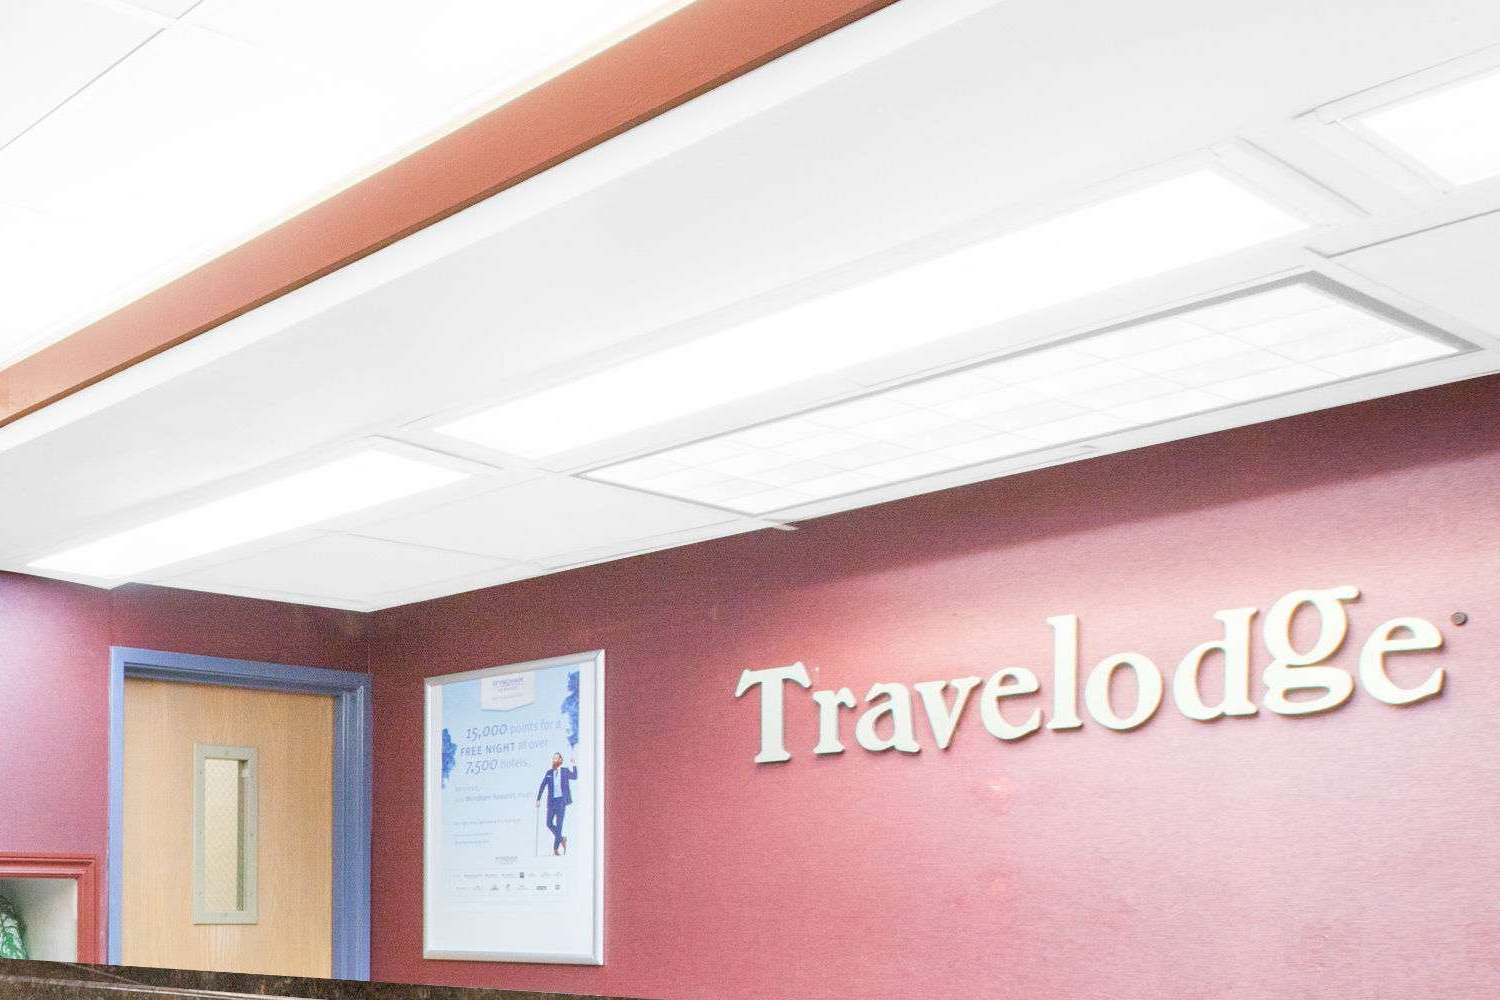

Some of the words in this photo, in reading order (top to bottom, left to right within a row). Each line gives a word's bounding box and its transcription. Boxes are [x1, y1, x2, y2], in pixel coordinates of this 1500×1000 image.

[734, 585, 1446, 763] Travelodge
[466, 724, 508, 741] 15,000
[510, 721, 538, 736] points
[460, 745, 482, 757] FREE
[485, 742, 515, 755] NIGHT
[465, 759, 499, 775] 7,500
